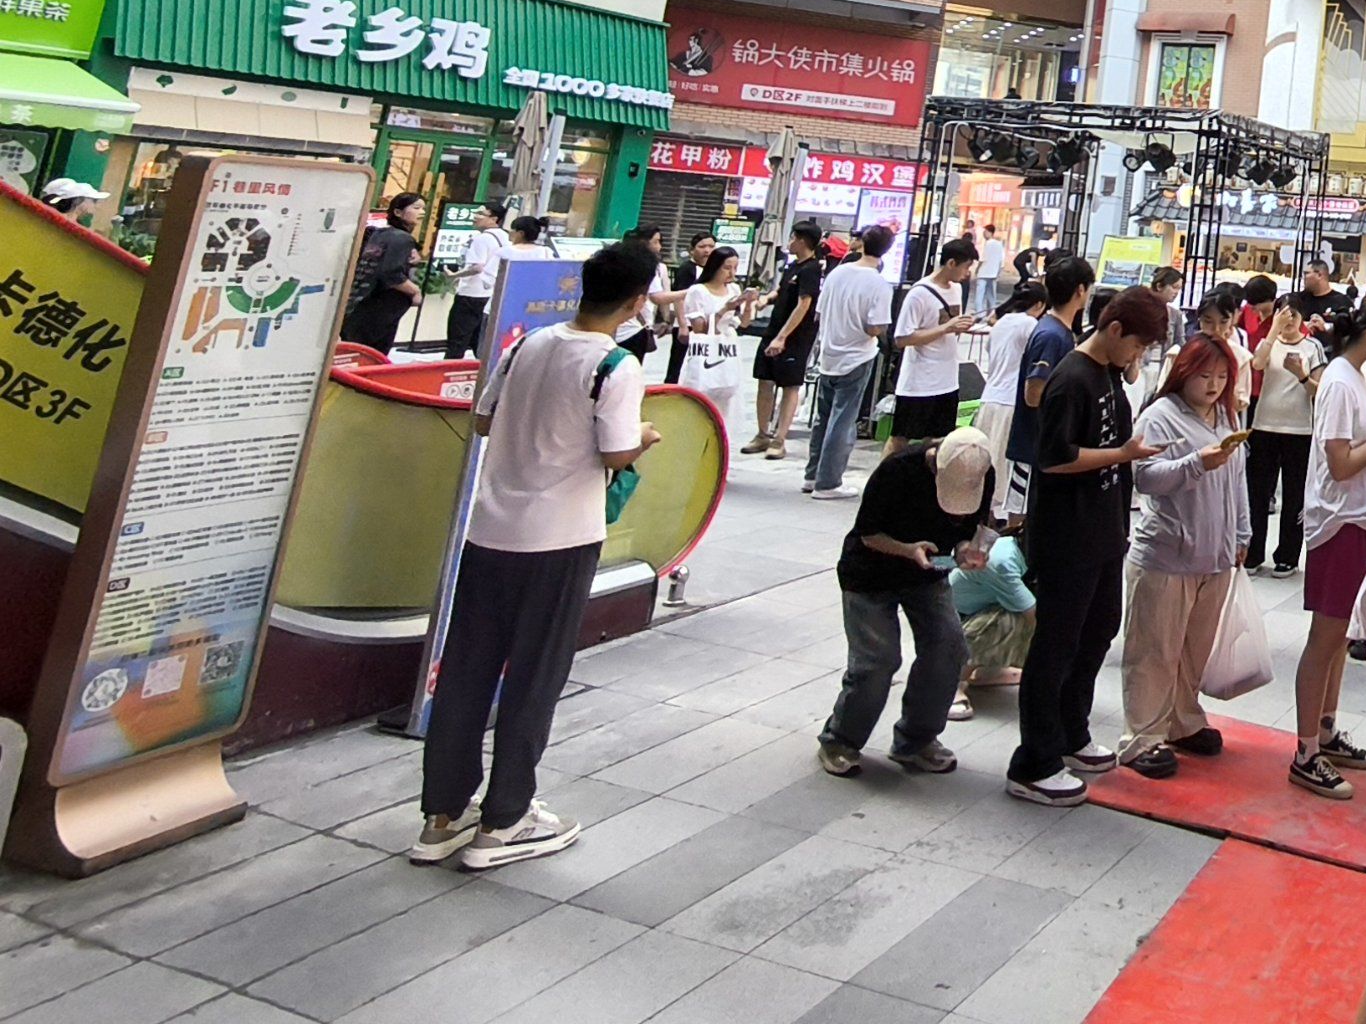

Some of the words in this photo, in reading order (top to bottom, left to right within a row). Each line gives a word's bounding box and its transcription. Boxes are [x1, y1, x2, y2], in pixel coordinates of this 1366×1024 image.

[732, 39, 916, 84] 锅大侠市集火锅
[762, 89, 802, 102] D区2F
[651, 141, 732, 170] 花甲粉
[764, 156, 916, 187] 炸鸡汉堡
